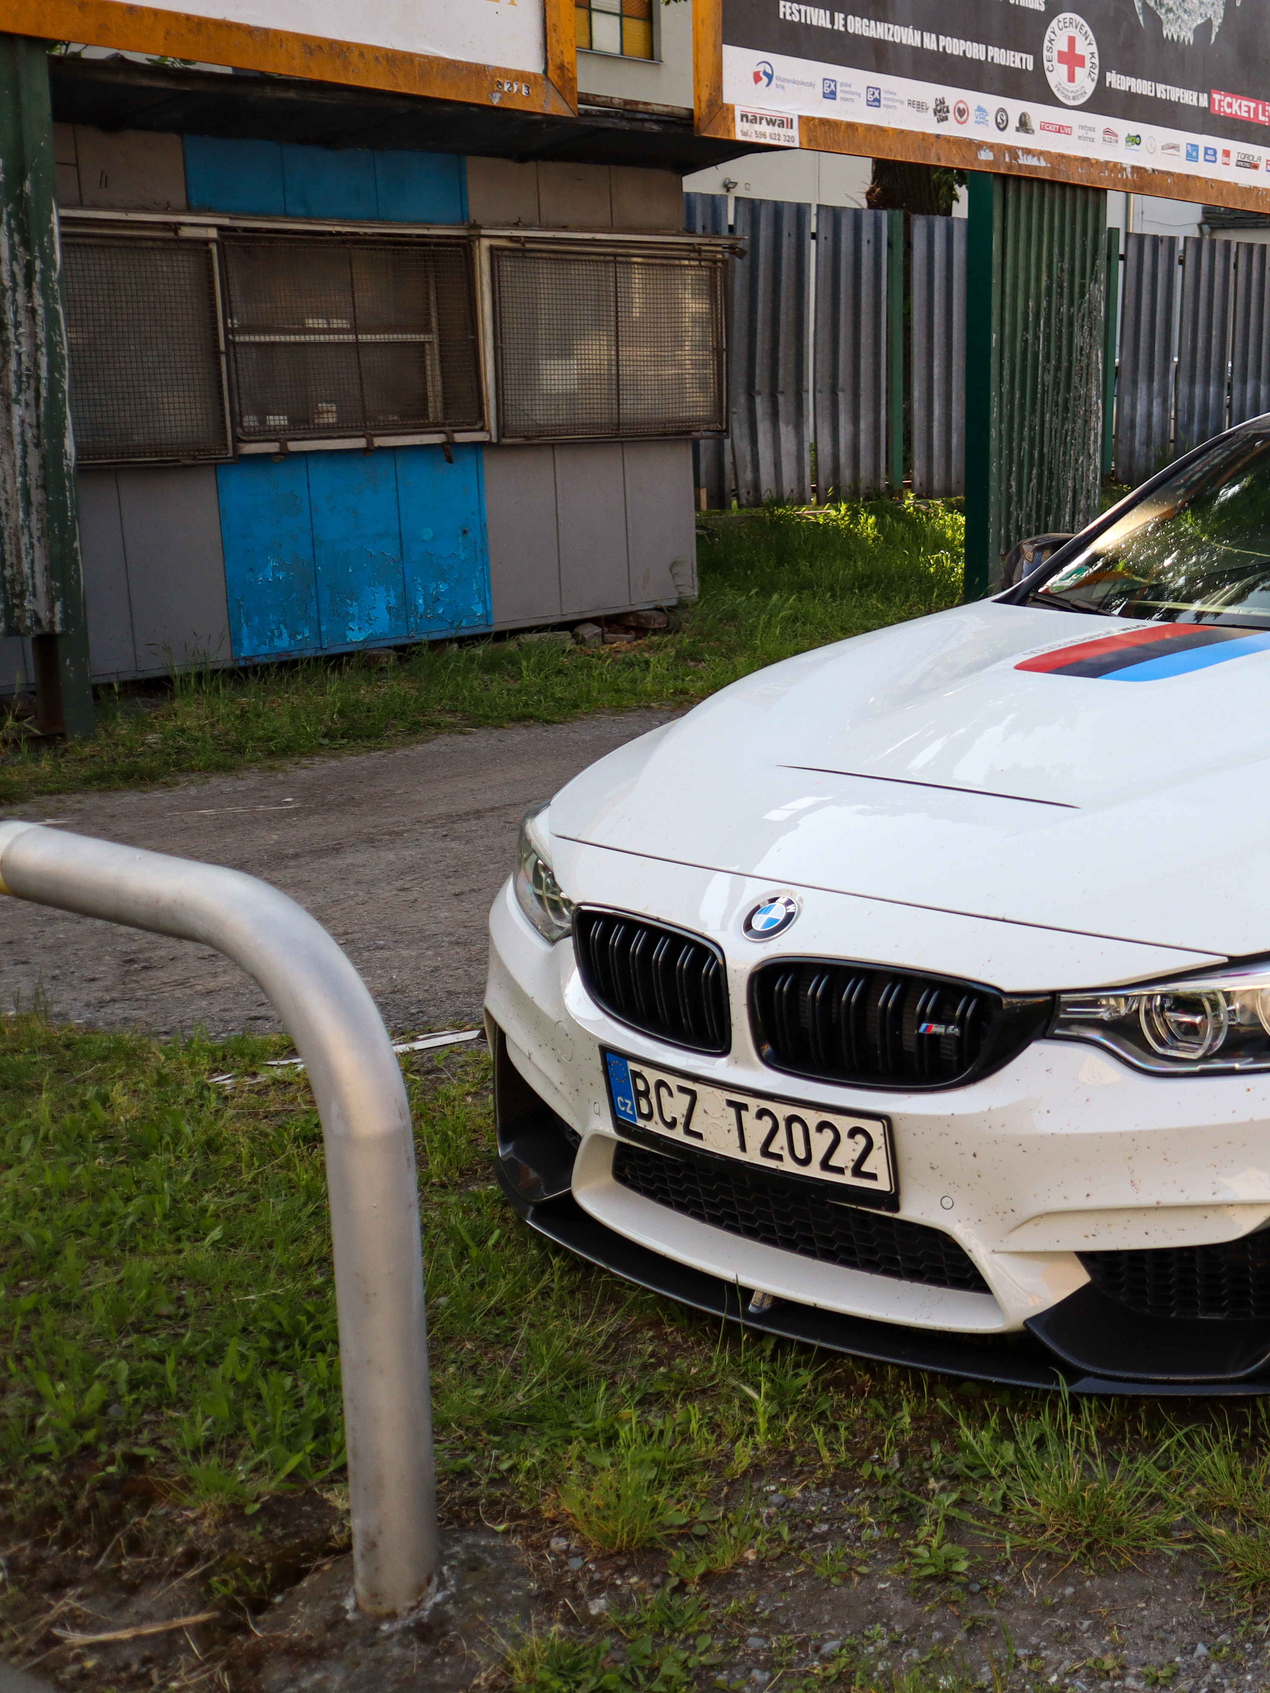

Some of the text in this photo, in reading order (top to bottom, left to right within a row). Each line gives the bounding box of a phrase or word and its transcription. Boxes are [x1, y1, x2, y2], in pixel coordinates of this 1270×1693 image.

[779, 1, 1034, 71] FESTIVAL JE ORGANIZOVÁN NA PODPORU PROJEKTU
[1106, 69, 1155, 97] PŘEDPRODEJ
[1155, 82, 1198, 106] VSTUPENEK
[1198, 92, 1208, 108] NA
[740, 113, 793, 129] narwall
[1212, 92, 1256, 118] TICKET
[617, 1096, 633, 1115] CZ
[630, 1068, 878, 1182] BCZ T2022
